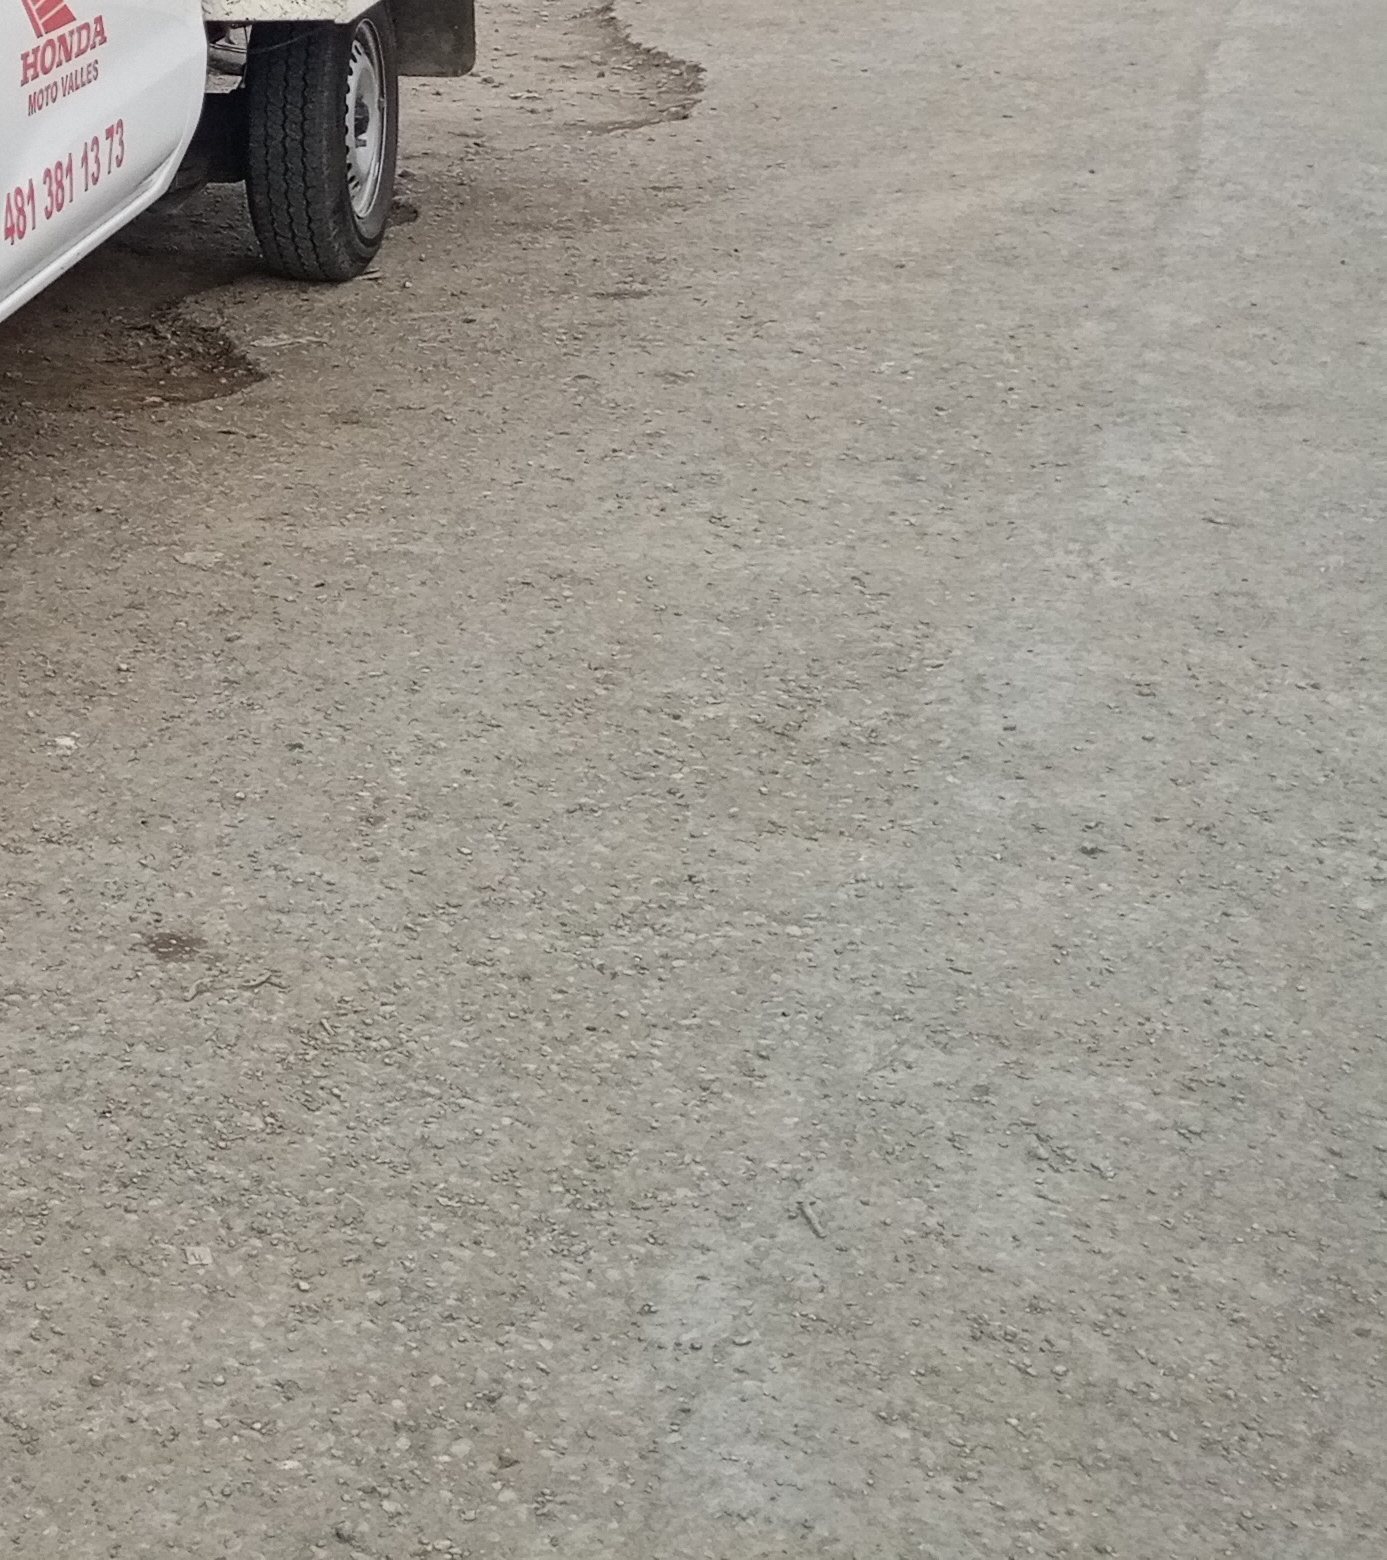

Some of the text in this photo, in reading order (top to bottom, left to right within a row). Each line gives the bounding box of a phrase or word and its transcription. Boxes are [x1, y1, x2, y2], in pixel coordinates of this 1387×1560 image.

[20, 15, 108, 87] HONDA
[28, 59, 100, 117] MOTO VALLES
[4, 119, 125, 246] 481 381 13 73
